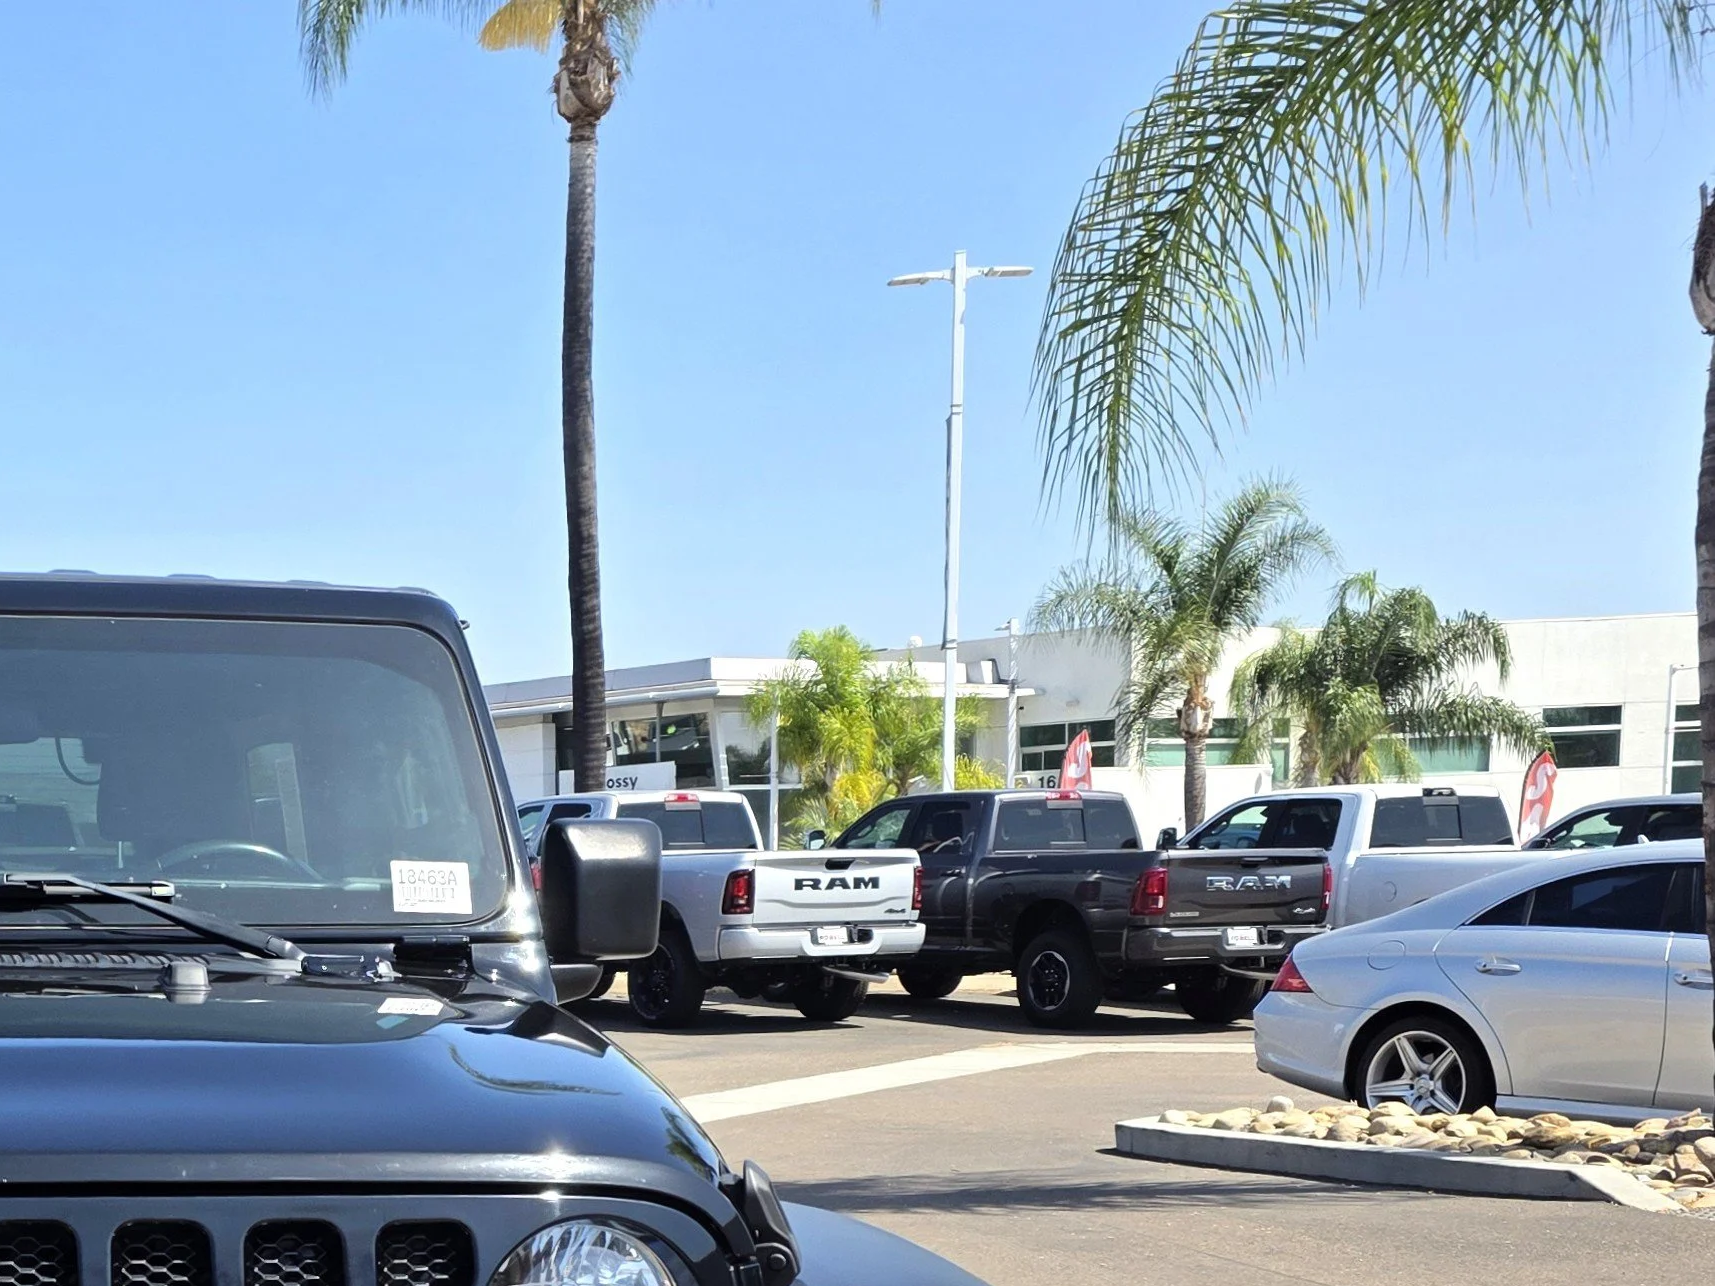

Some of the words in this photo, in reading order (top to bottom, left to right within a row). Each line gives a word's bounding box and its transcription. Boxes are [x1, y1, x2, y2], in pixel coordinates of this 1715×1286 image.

[606, 776, 638, 790] ossy
[398, 868, 458, 886] 18463A
[794, 876, 880, 891] RAM
[1206, 875, 1291, 891] RAM
